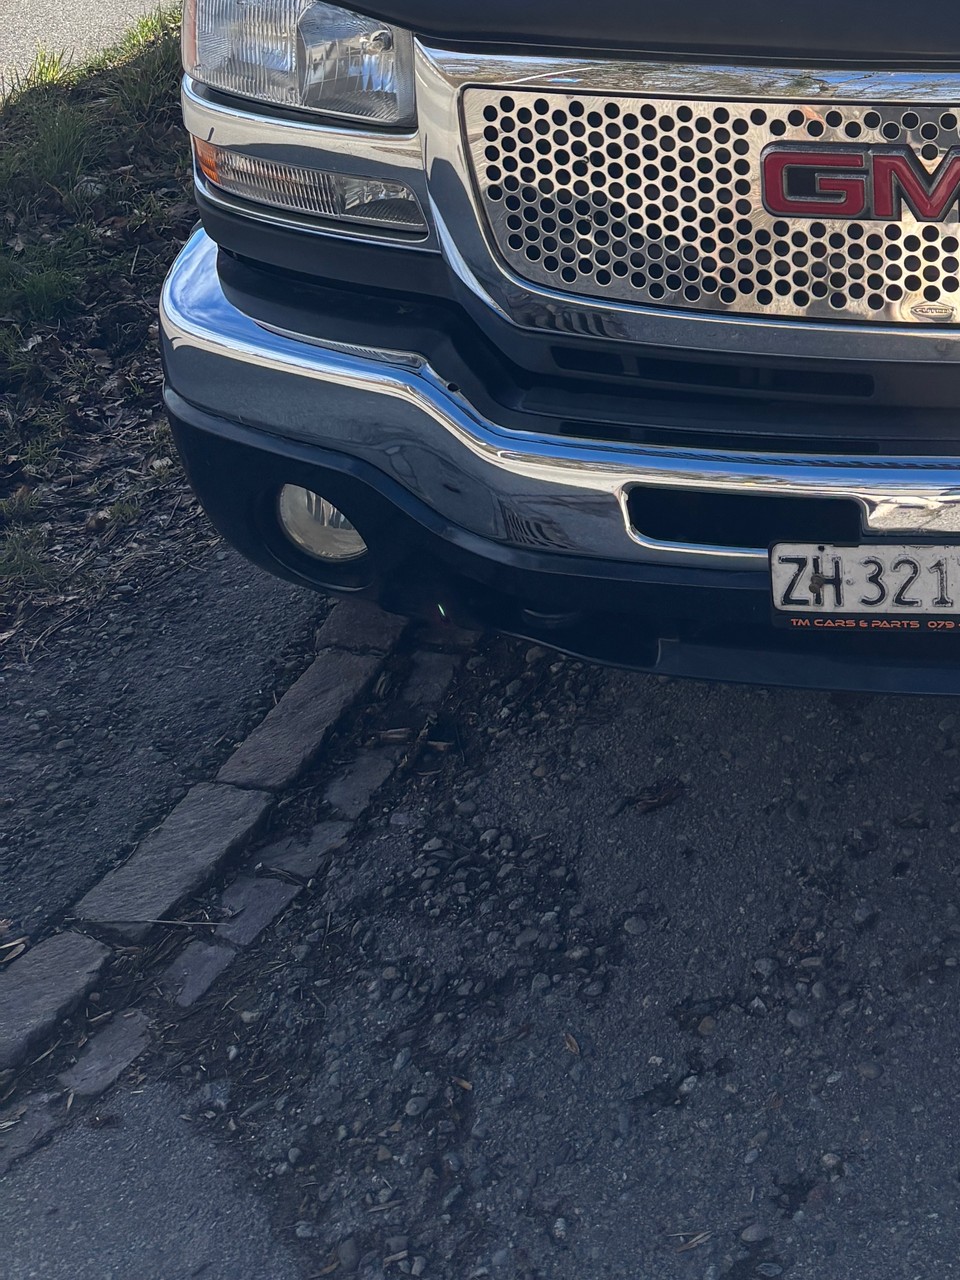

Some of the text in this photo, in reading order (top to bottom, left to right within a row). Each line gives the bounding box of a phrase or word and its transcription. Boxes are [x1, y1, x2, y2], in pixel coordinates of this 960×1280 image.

[790, 618, 811, 627] TM
[813, 619, 857, 628] CARS
[858, 619, 869, 629] &
[871, 620, 920, 629] PARTS
[927, 620, 956, 630] 079
